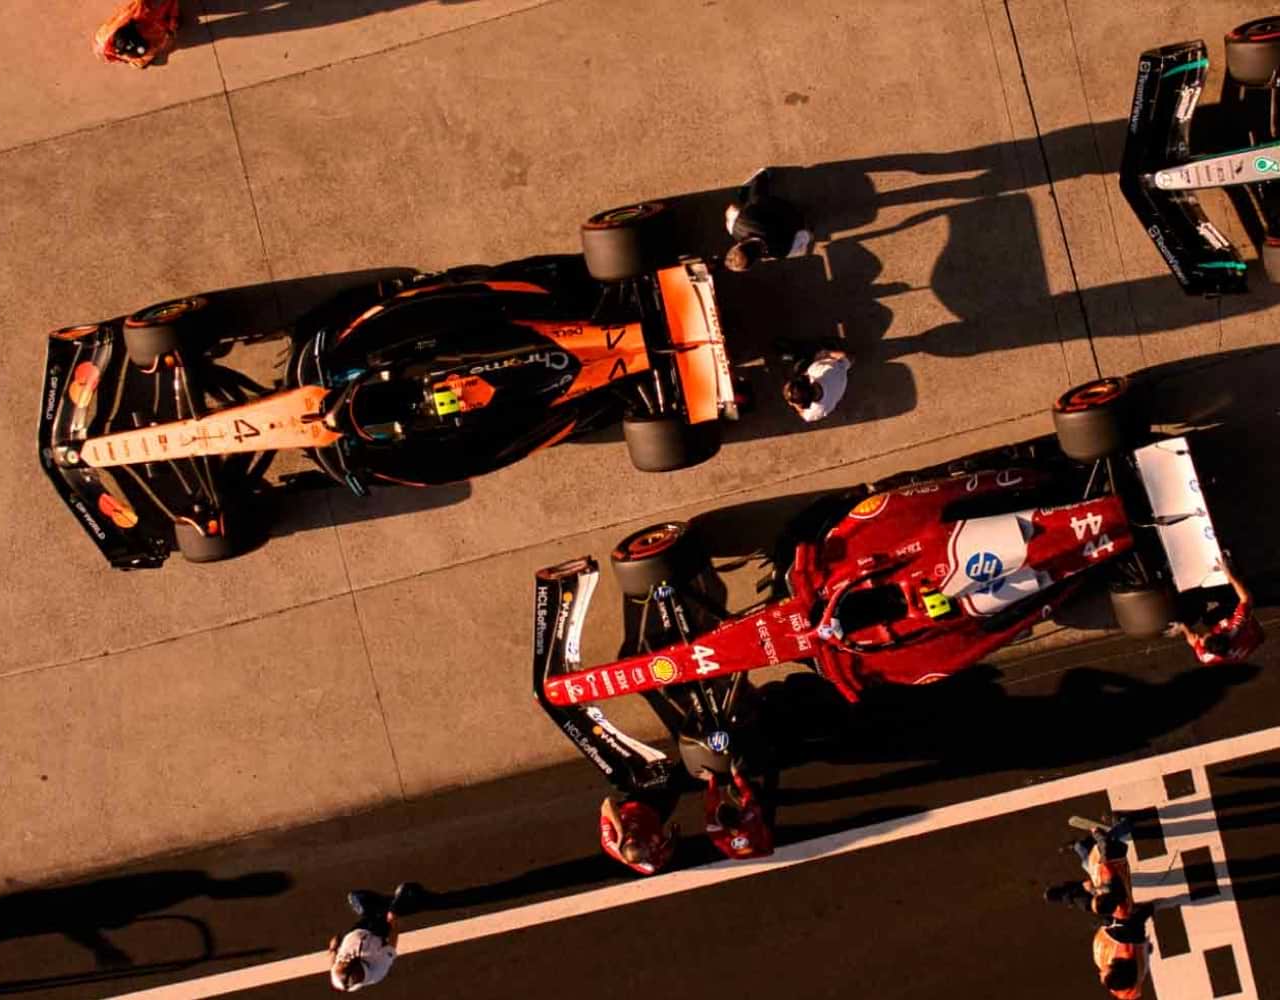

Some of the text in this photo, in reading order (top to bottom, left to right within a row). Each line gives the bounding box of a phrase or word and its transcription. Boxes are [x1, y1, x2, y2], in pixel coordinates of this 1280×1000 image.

[469, 350, 570, 375] Chrome
[233, 418, 261, 443] 4
[1070, 512, 1104, 541] 44
[789, 612, 809, 651] PEONI
[691, 645, 721, 675] 44
